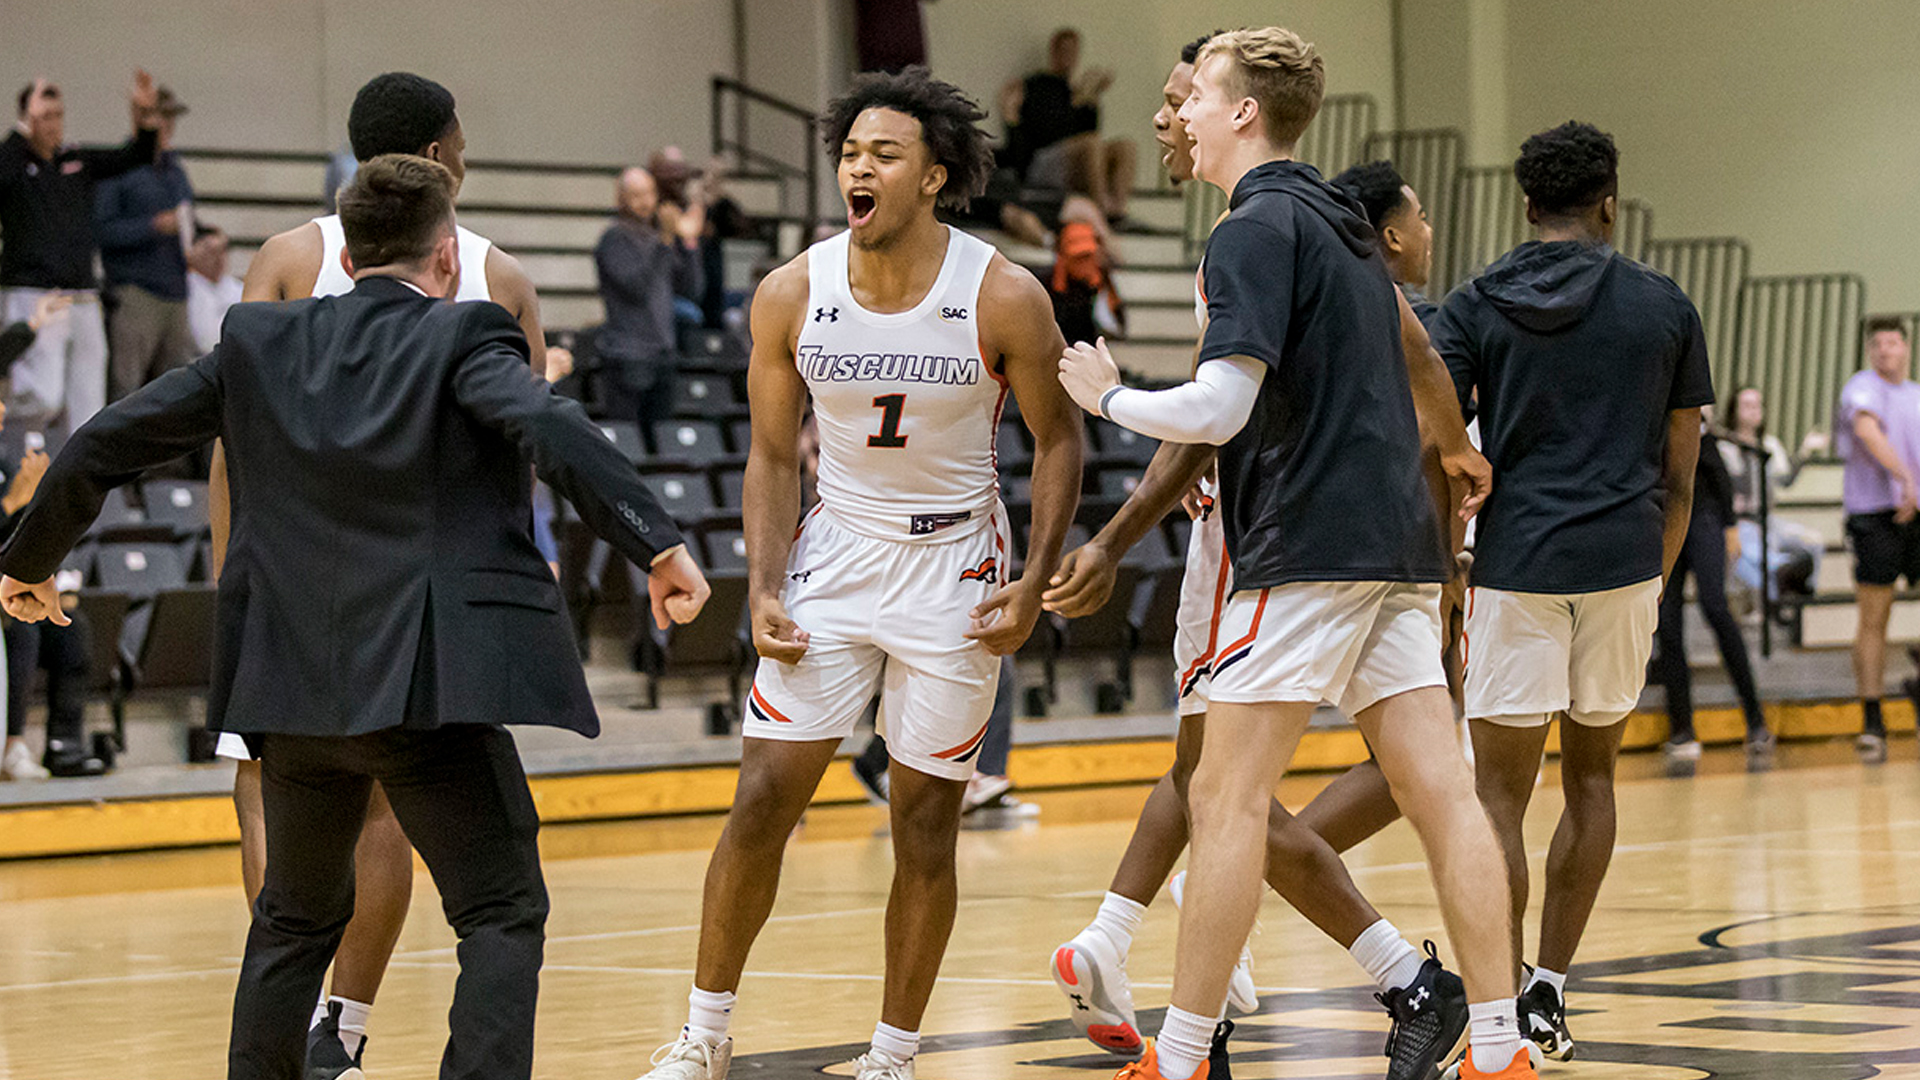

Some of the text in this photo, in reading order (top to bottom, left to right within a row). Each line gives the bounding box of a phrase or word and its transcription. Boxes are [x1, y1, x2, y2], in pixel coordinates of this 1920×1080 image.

[941, 306, 968, 321] SAC
[798, 345, 980, 385] TUSCULUM
[866, 393, 909, 449] 1
